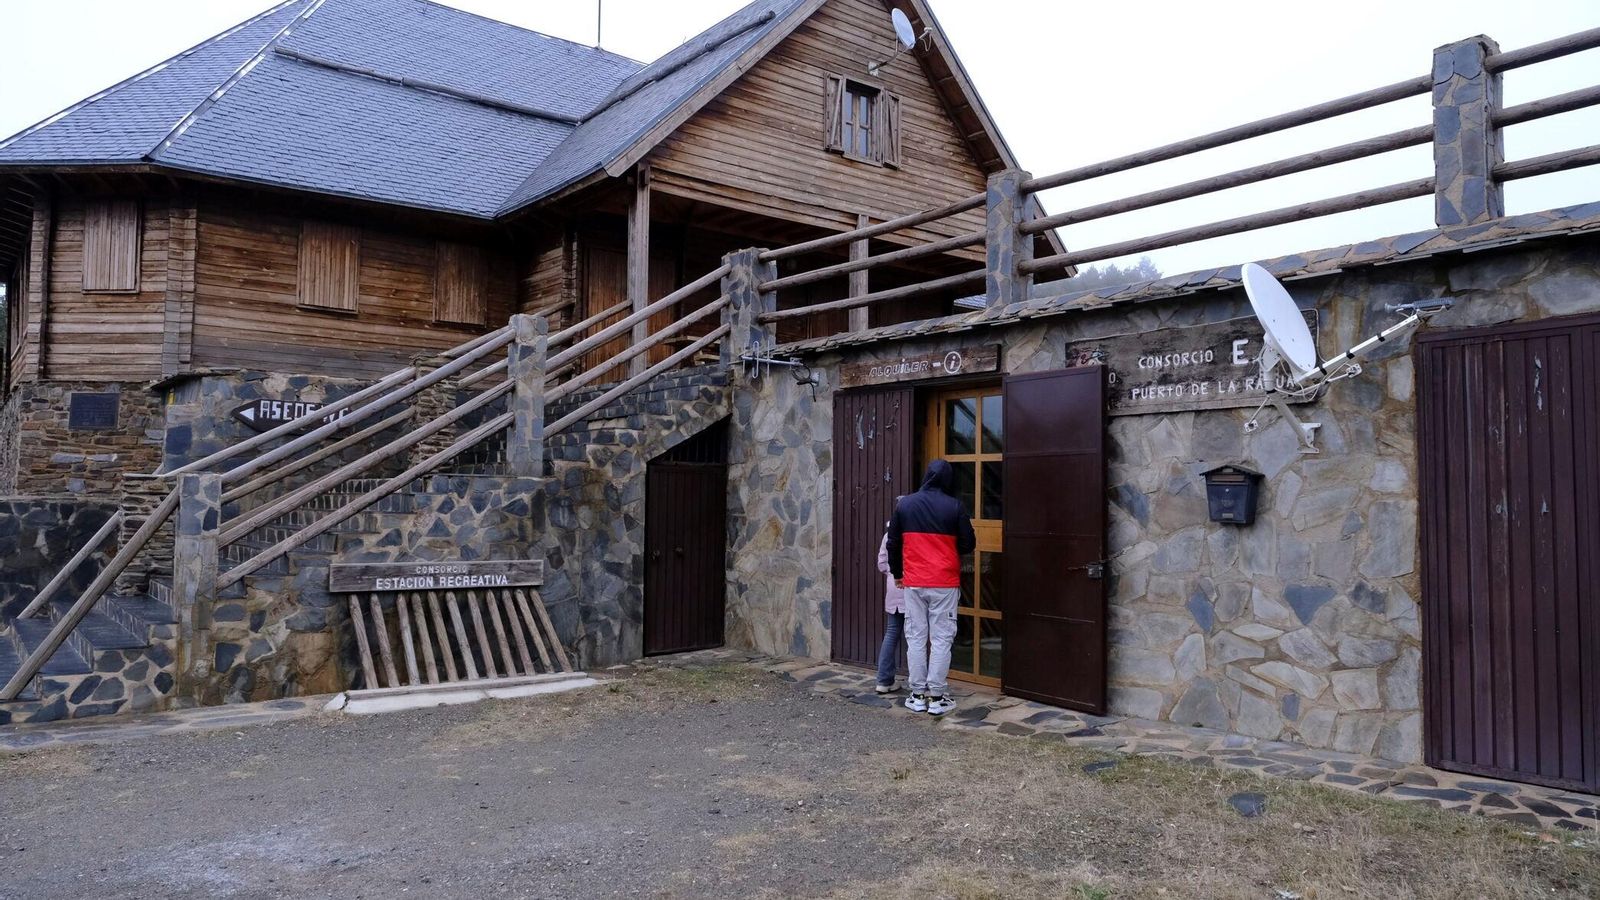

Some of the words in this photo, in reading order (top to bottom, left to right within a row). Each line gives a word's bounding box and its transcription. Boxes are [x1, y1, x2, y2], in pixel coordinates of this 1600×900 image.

[1132, 384, 1183, 400] PUERTO
[1191, 382, 1208, 396] DE
[1218, 379, 1236, 393] LA
[1245, 376, 1295, 391] RAUA
[416, 565, 468, 574] CONSORCIO
[376, 576, 434, 590] ESTACION
[439, 575, 508, 588] RECREATIVA
